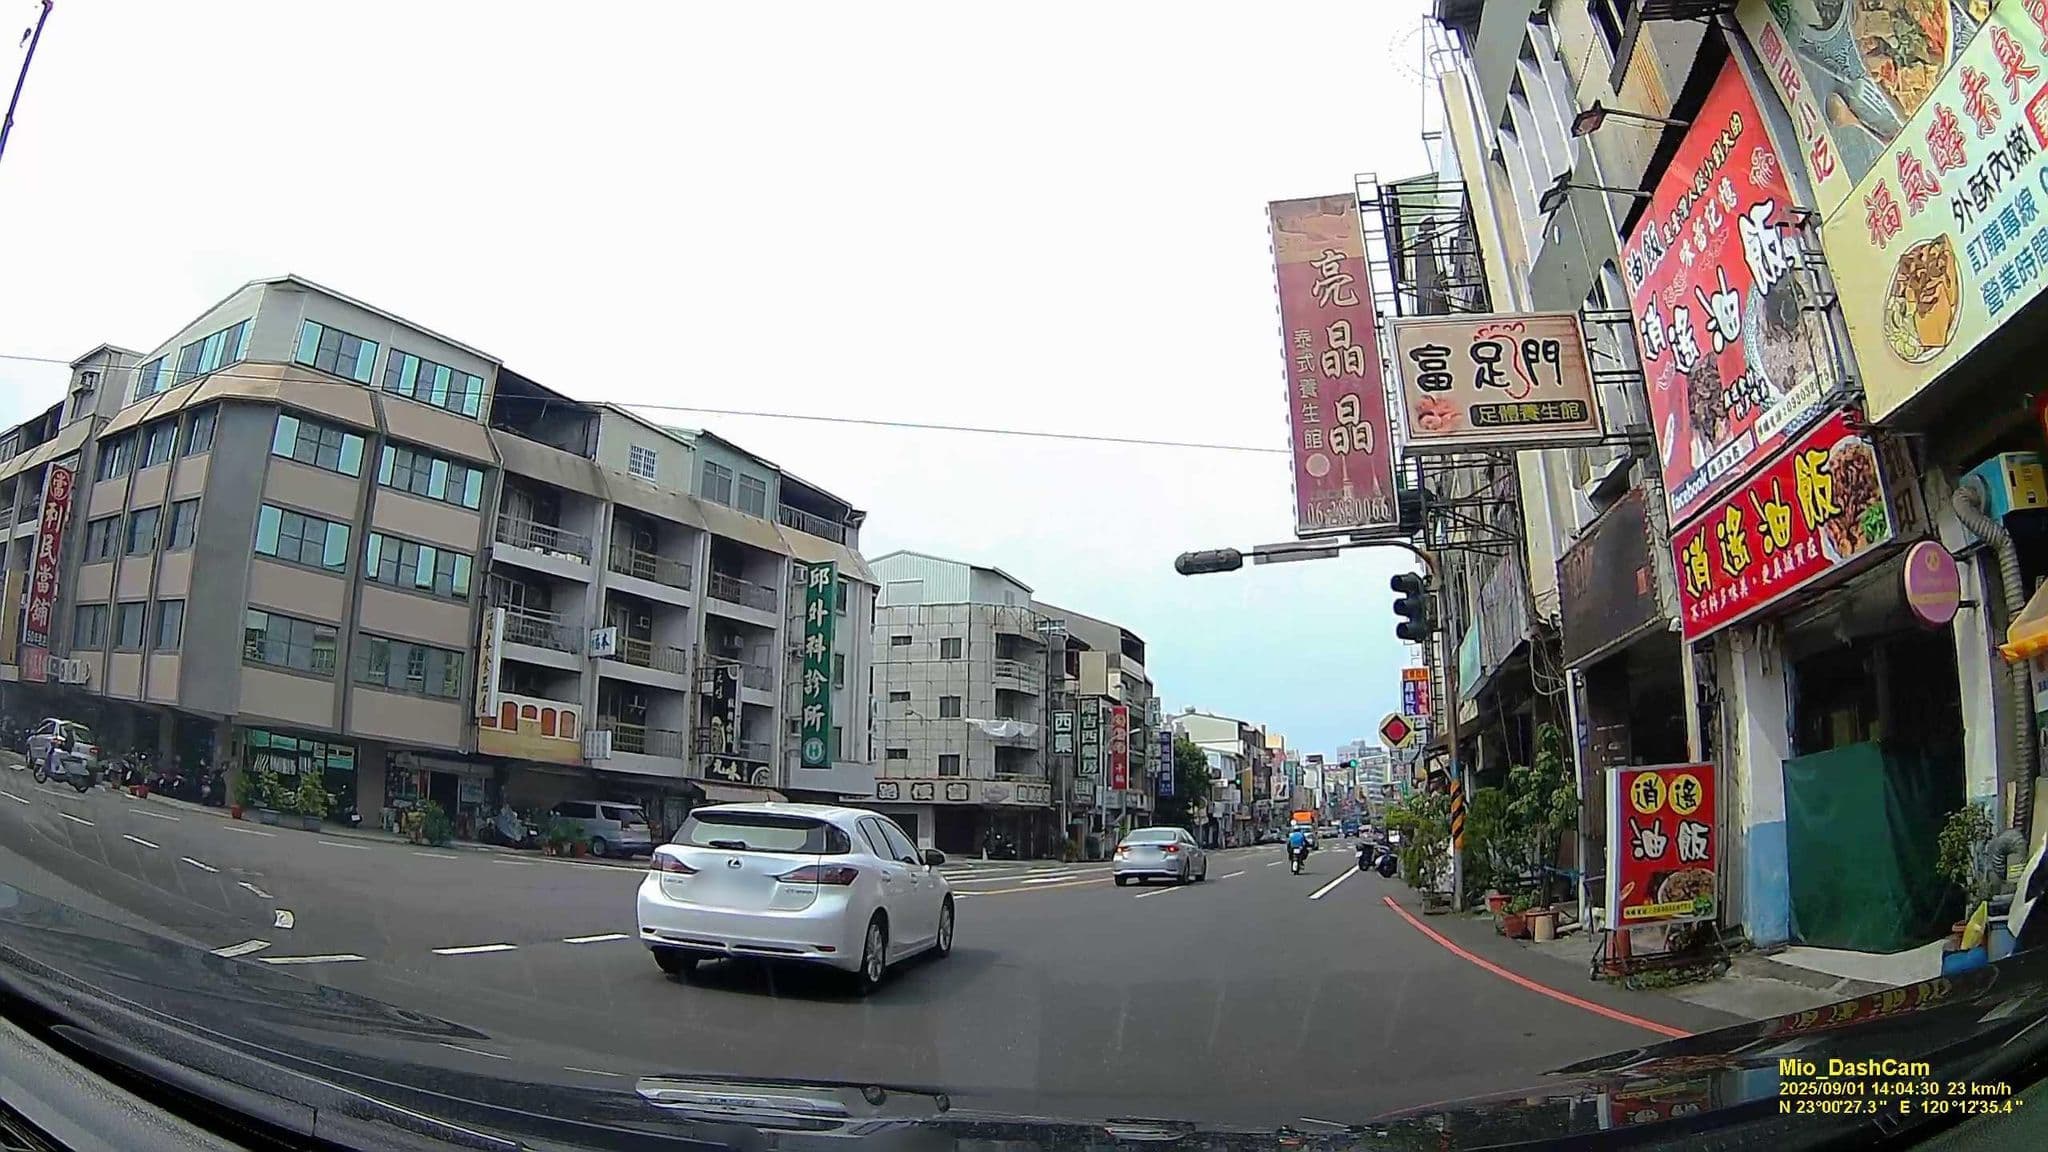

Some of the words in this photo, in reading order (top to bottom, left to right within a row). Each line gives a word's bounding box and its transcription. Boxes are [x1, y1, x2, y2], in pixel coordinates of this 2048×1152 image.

[1625, 218, 1666, 298] 油飯
[1965, 186, 2041, 277] 訂購專線
[1640, 198, 1791, 375] 逍遙油飯
[1294, 329, 1324, 449] 泰式養生館
[1309, 249, 1375, 456] 亮晶晶
[1408, 338, 1562, 394] 富足門
[1477, 403, 1582, 424] 足體養生館
[1672, 470, 1709, 513] facebook
[1681, 448, 1843, 600] 逍遙油飯
[802, 566, 831, 733] 邱外科診所
[1054, 712, 1073, 753] 西藥
[1634, 776, 1698, 812] 逍遙
[1629, 817, 1710, 863] 油飯
